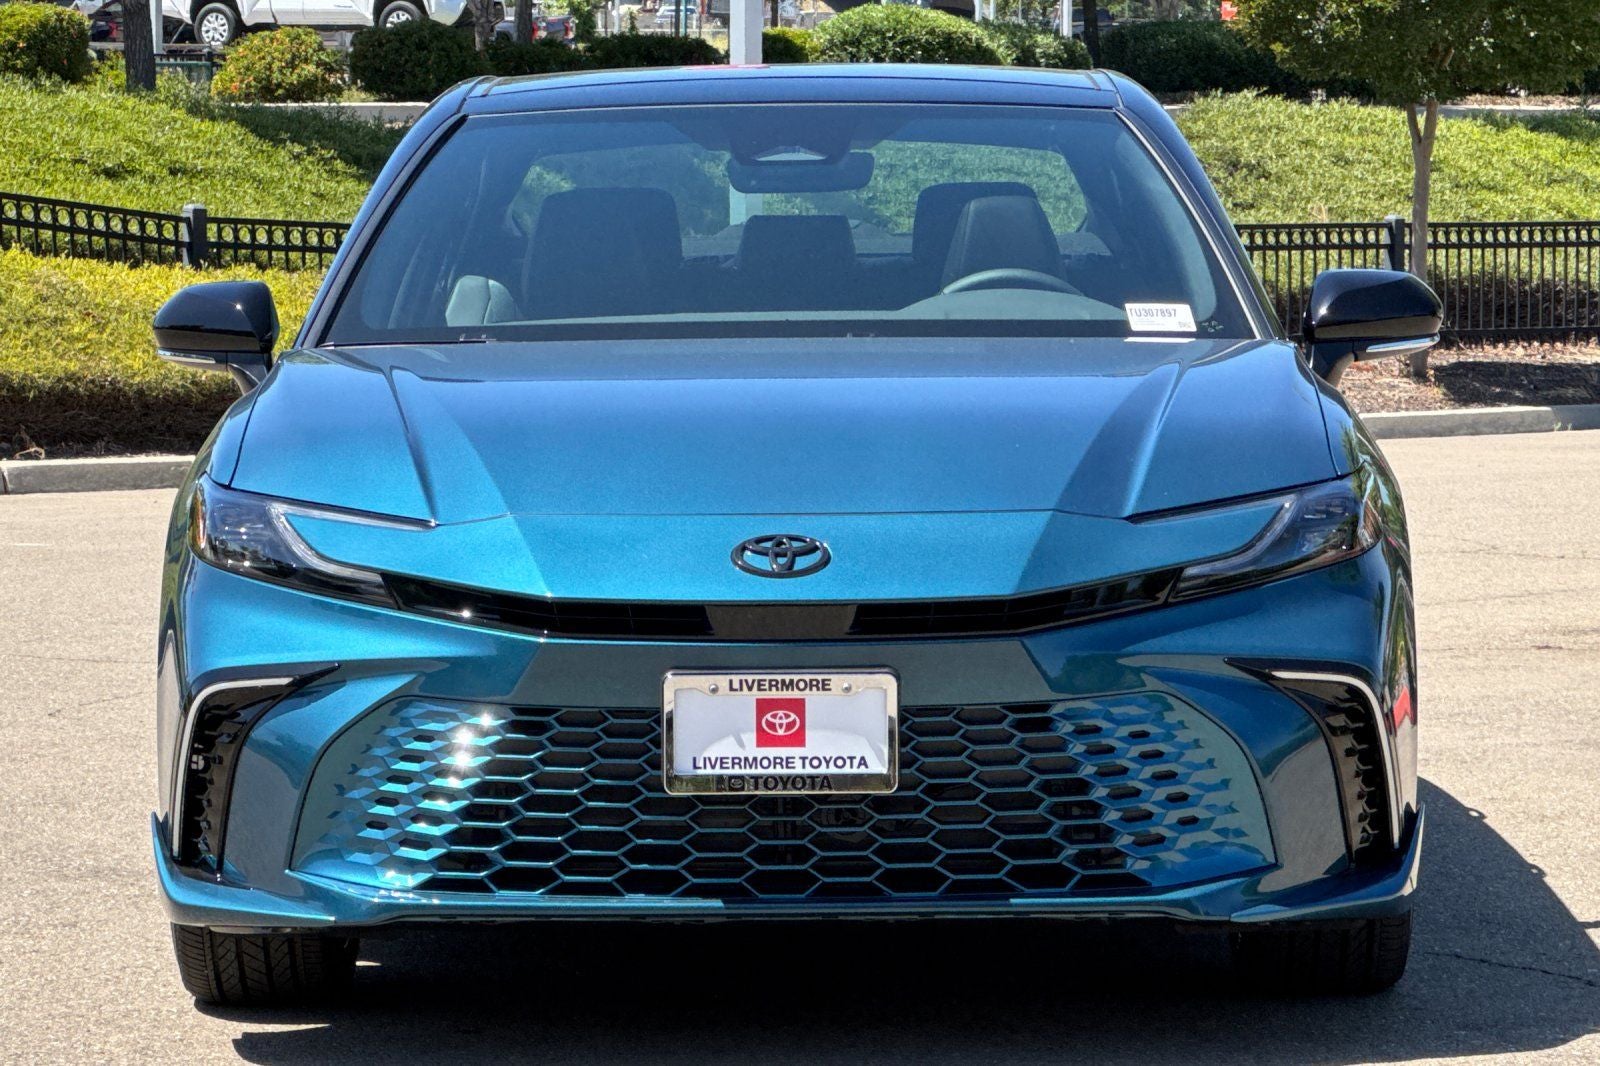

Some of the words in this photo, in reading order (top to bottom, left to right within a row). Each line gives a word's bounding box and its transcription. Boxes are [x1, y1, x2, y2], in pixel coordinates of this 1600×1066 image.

[728, 678, 832, 692] LIVERMORE
[692, 756, 796, 770] LIVERMORE
[799, 755, 869, 769] TOYOTA
[750, 775, 833, 791] TOYOTA
